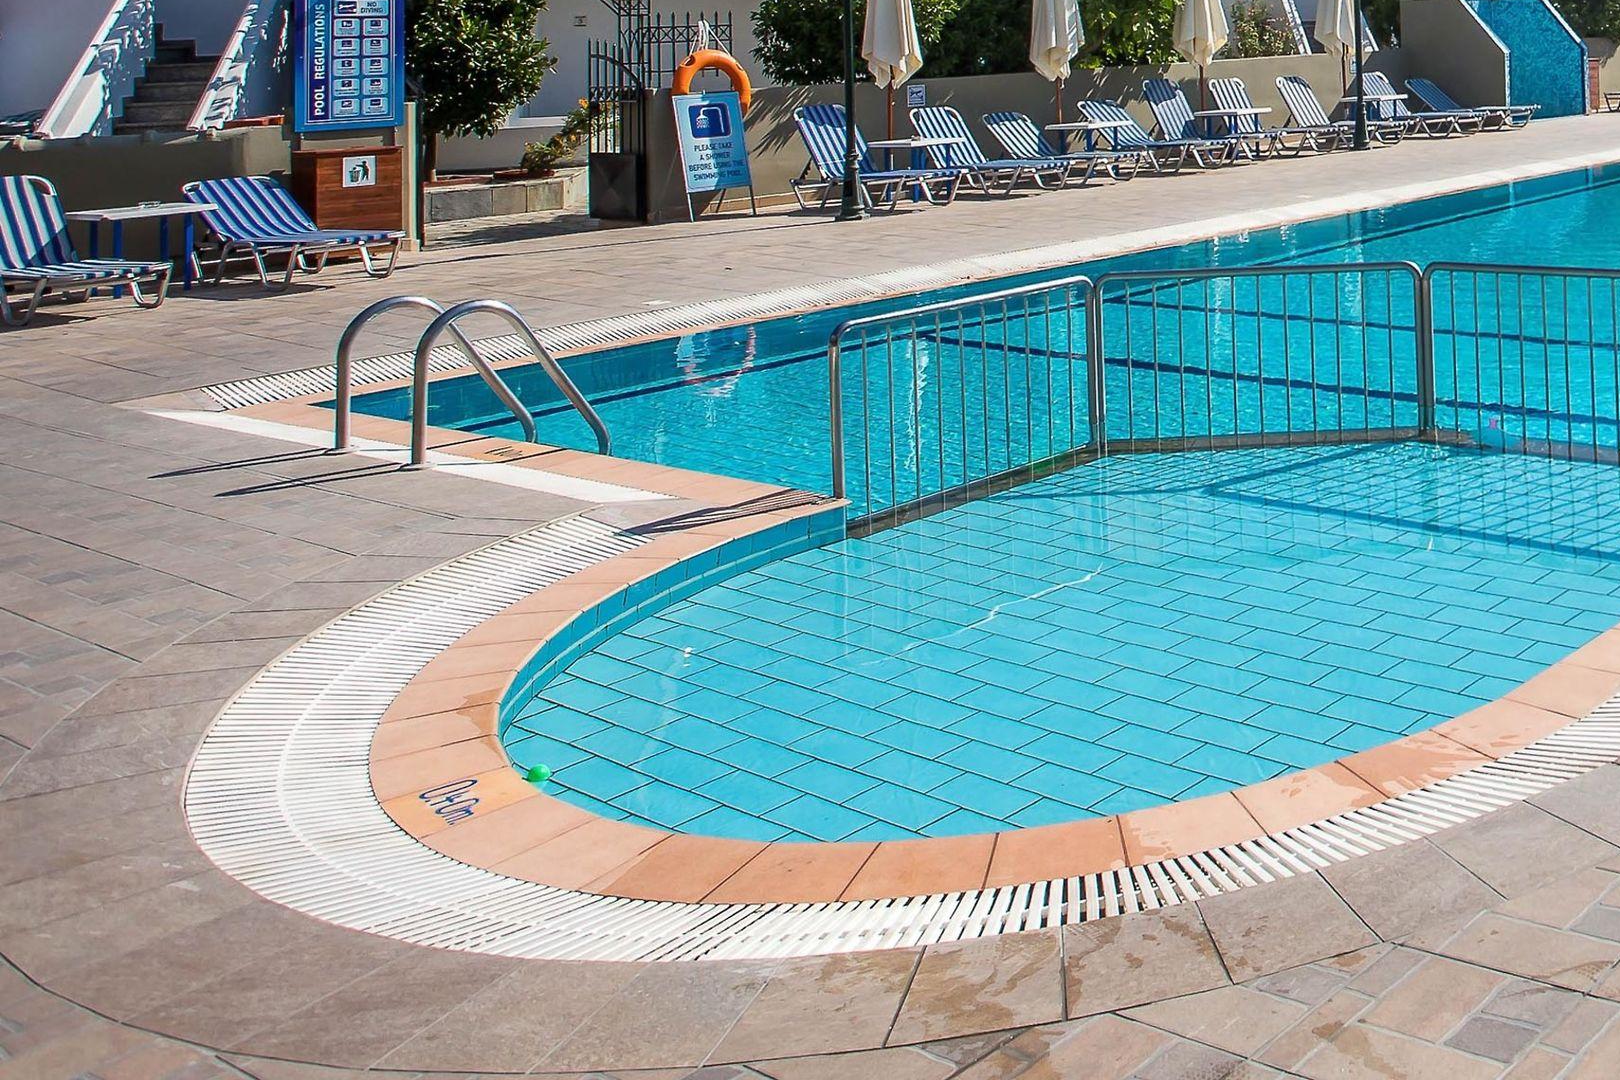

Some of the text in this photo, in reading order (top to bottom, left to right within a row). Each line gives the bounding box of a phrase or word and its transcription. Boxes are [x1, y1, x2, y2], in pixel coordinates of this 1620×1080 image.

[314, 3, 325, 116] POOL REGULATIONS
[694, 141, 734, 151] PLEASE TAKE
[706, 151, 730, 160] SHOWER
[689, 163, 712, 172] BEFORE
[713, 161, 732, 169] USING
[693, 169, 743, 181] SWIMMING POOL
